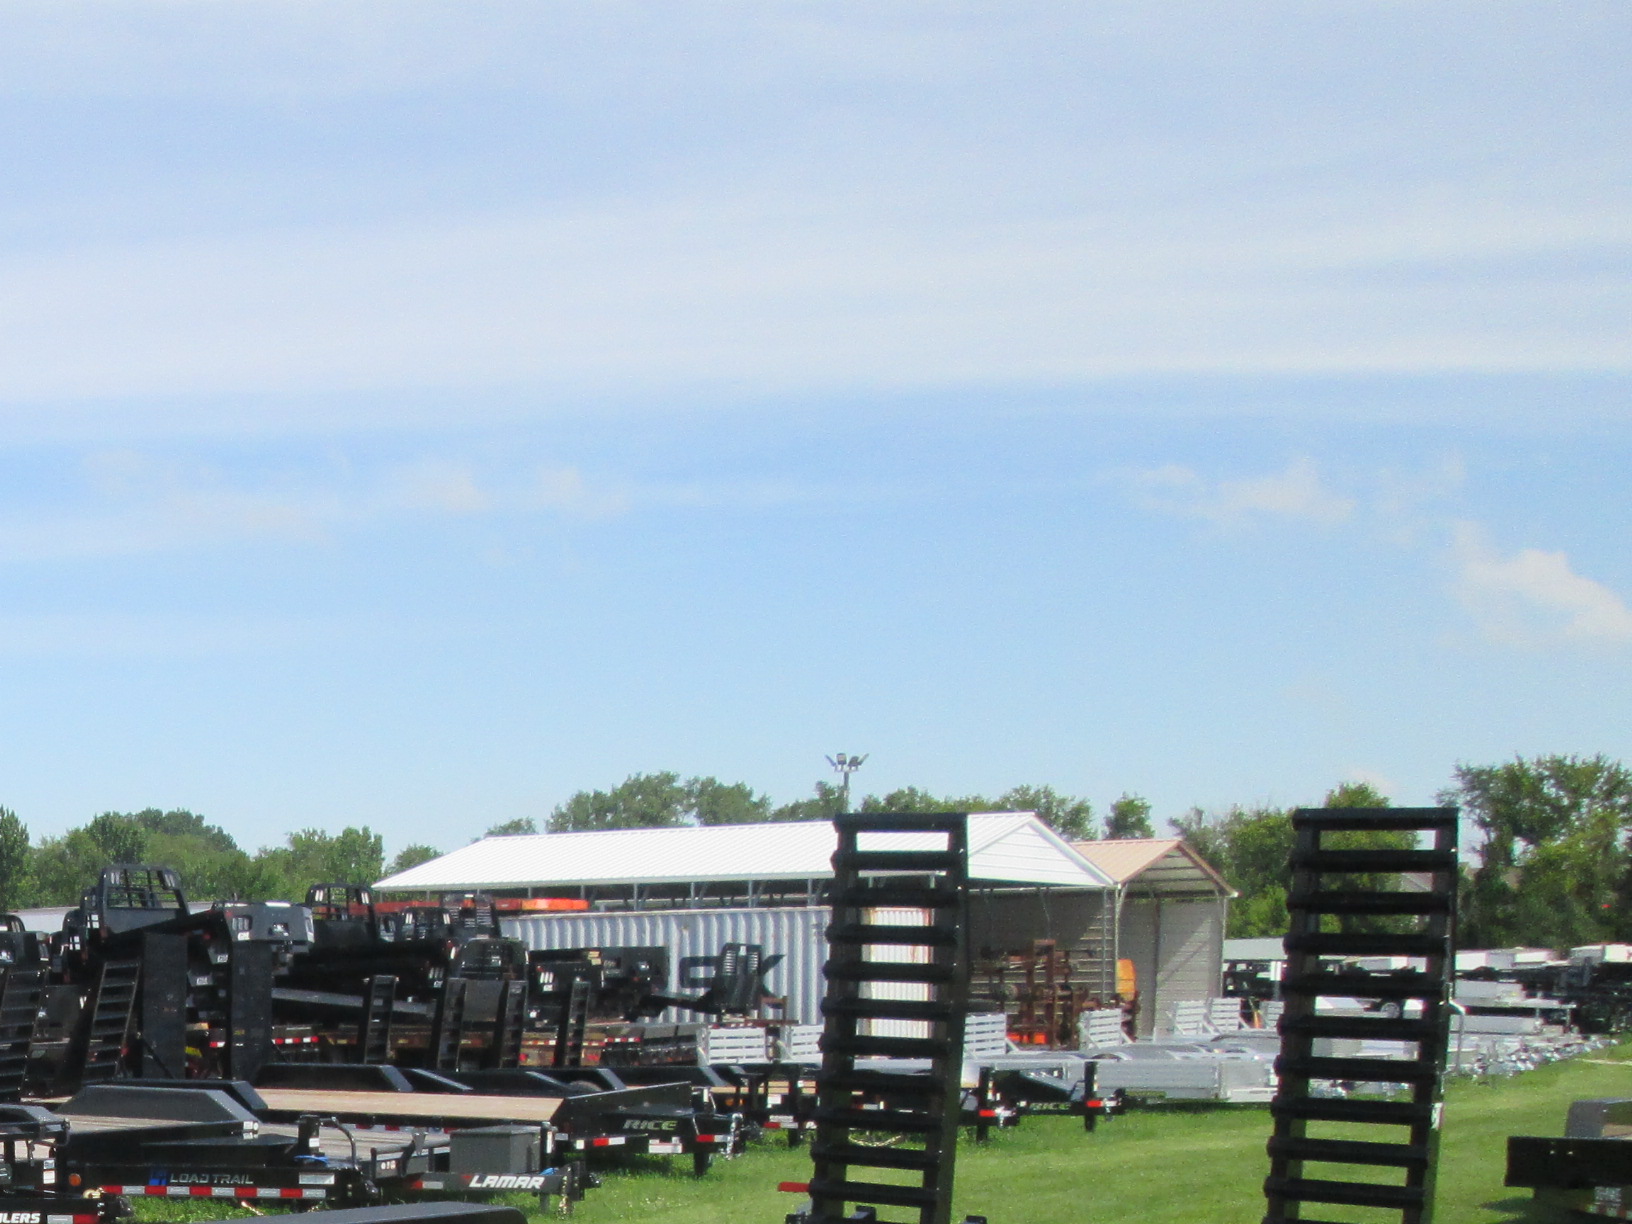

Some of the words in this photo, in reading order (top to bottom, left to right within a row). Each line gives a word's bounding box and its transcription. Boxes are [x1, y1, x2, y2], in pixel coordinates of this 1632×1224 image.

[623, 1119, 678, 1130] RICE
[170, 1173, 210, 1184] LOAD
[212, 1174, 254, 1185] TRAIL
[469, 1175, 545, 1190] LAMAR
